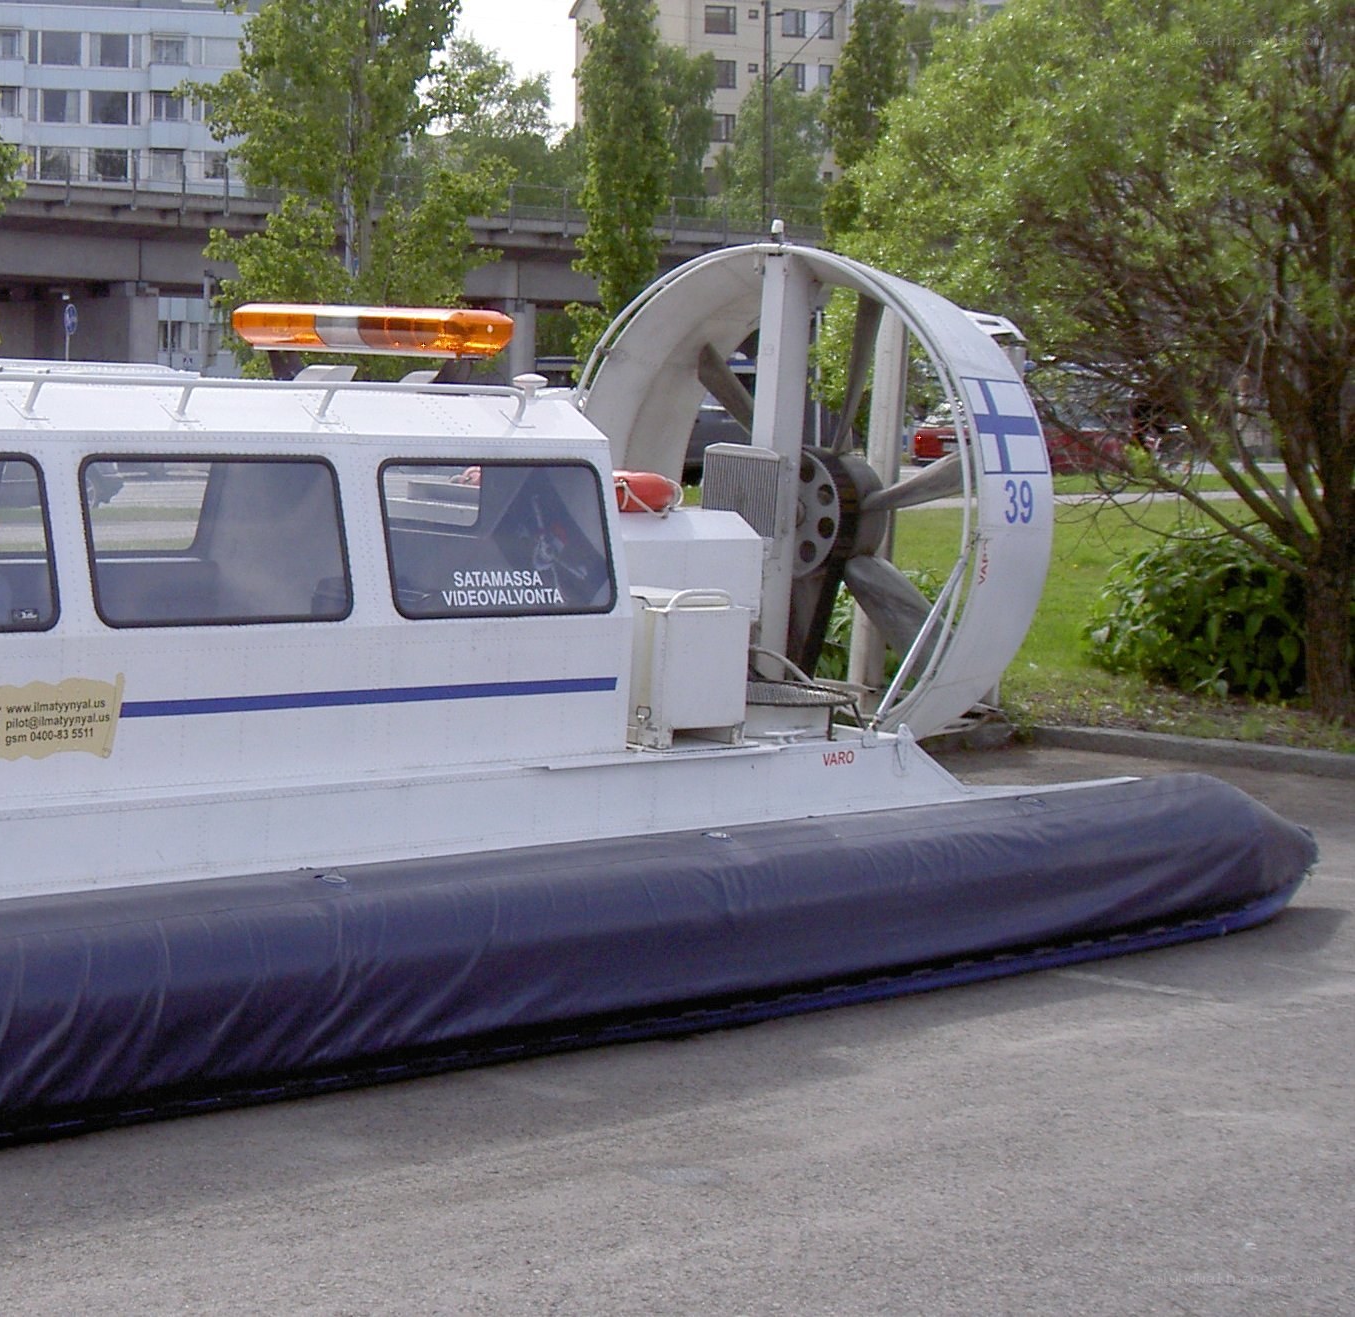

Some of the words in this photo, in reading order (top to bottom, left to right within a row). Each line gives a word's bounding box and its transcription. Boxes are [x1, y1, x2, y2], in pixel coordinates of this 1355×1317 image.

[1004, 479, 1034, 525] 39
[453, 570, 543, 588] SATAMASSA
[442, 588, 564, 607] VIDEOVALVONTA
[6, 698, 106, 715] www.ilmatyynyal.us
[5, 713, 110, 731] pilot@ilmatyynyal.us
[5, 734, 27, 746] gsm
[30, 729, 69, 742] 0400-83
[71, 727, 94, 739] 5511
[822, 750, 855, 767] VARO
